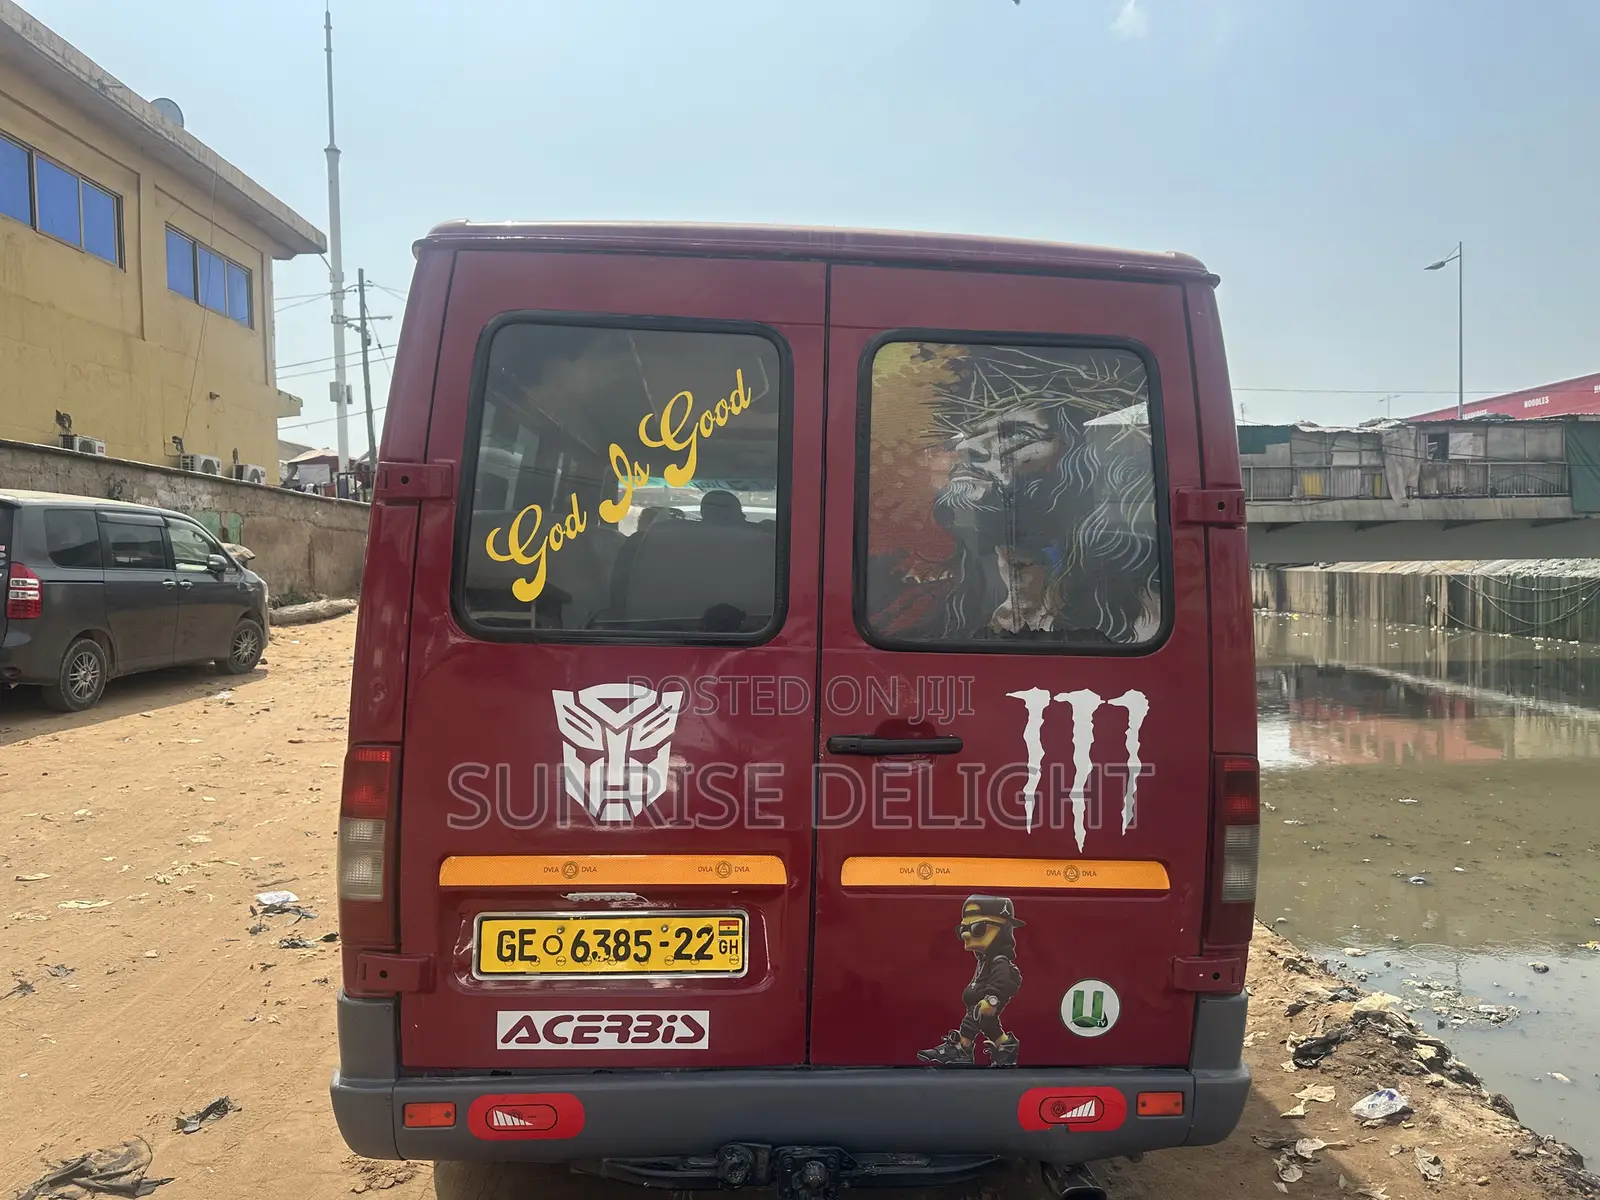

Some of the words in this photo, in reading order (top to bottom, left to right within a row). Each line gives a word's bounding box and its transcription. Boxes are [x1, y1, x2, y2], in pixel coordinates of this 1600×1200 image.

[1524, 396, 1549, 408] NOODLES
[486, 493, 587, 602] God
[599, 443, 650, 524] Is
[638, 368, 751, 487] Good
[697, 865, 713, 873] DVLA
[734, 865, 750, 873] DVLA
[935, 867, 951, 875] DVLA
[1046, 869, 1062, 877] DVLA
[496, 928, 538, 962] GE
[718, 938, 739, 955] GH
